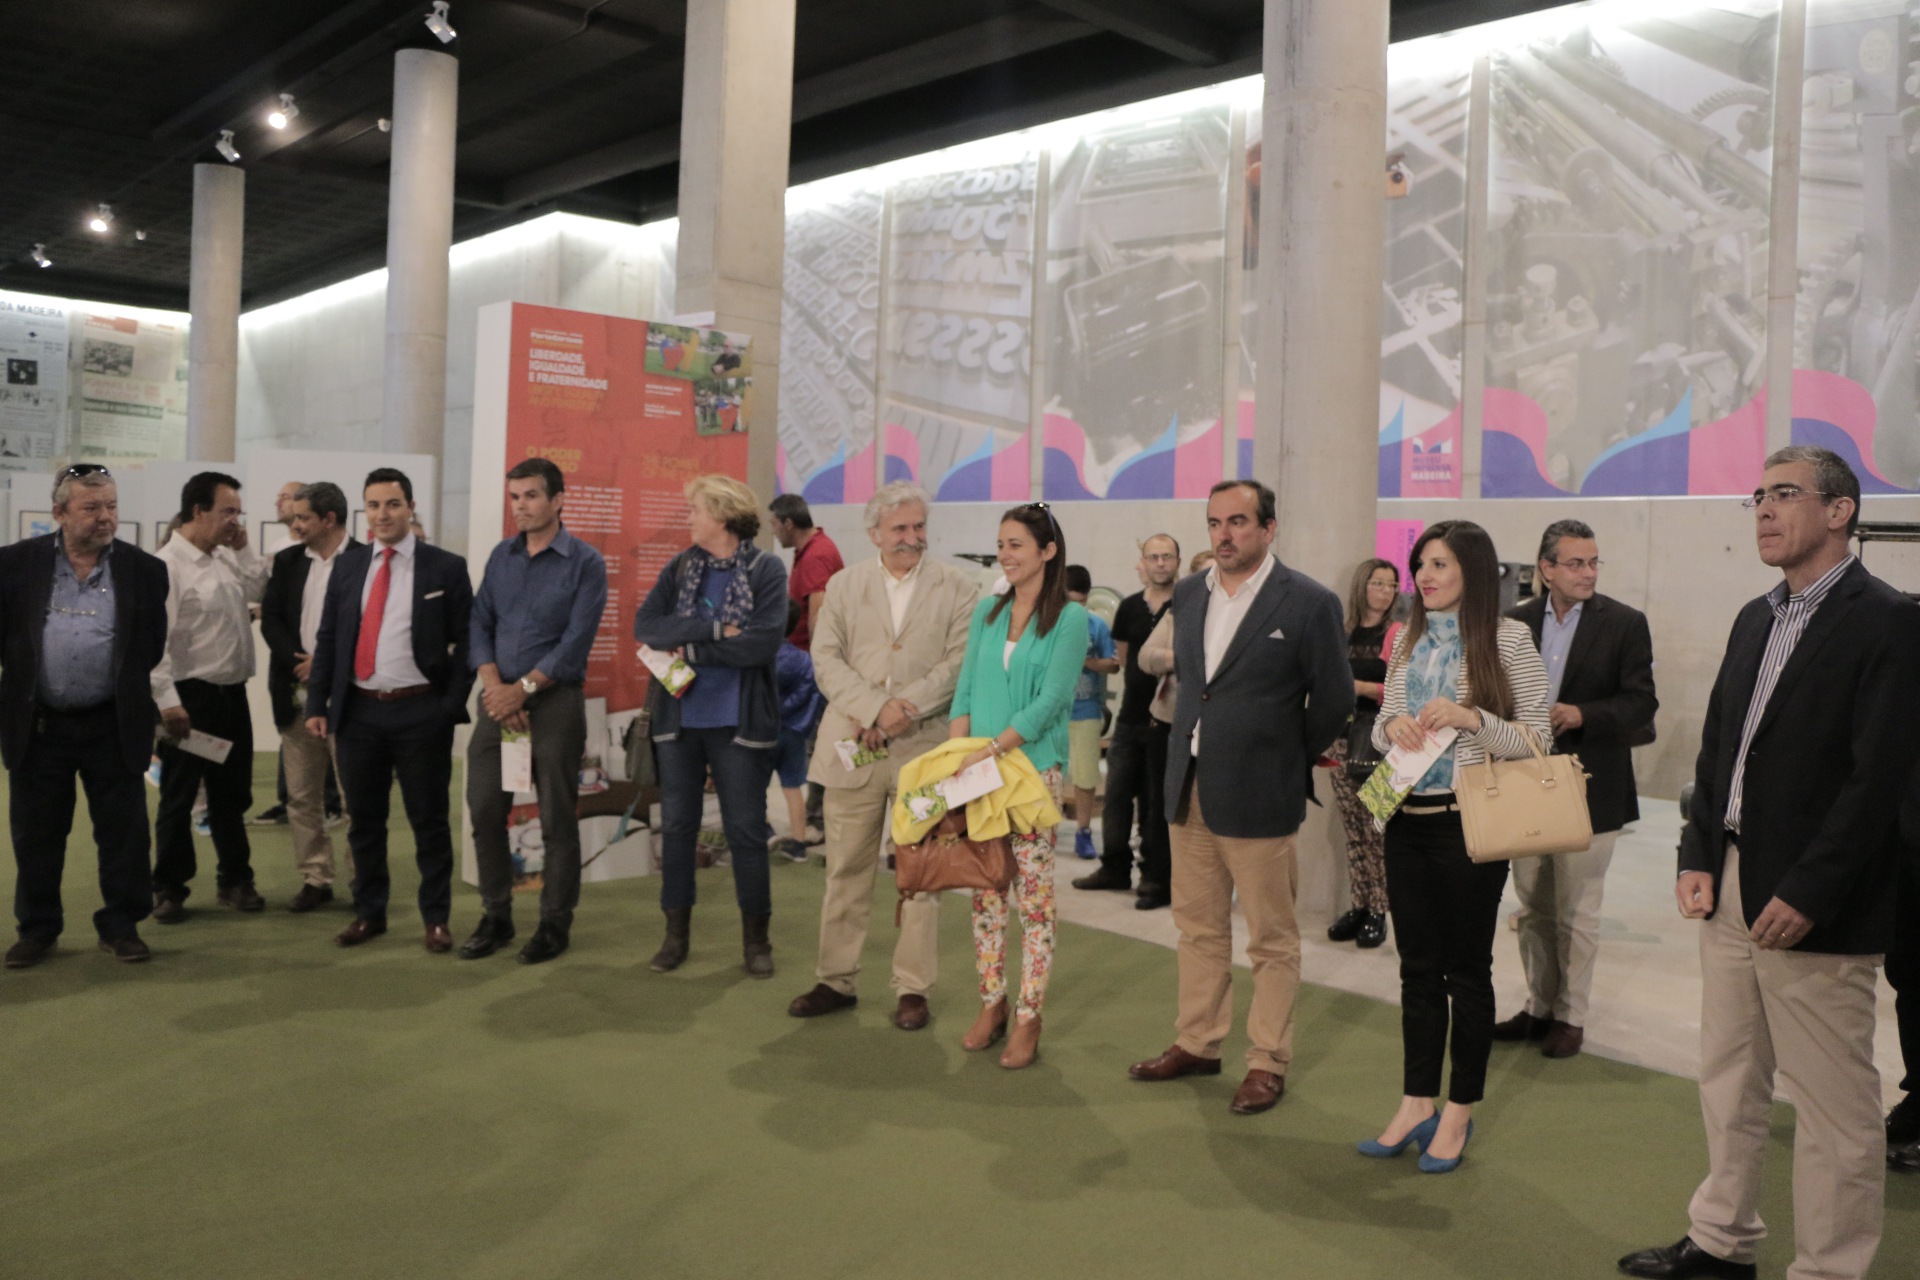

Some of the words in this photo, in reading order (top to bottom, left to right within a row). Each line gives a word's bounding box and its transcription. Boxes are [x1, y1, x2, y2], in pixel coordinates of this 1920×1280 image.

[529, 359, 585, 375] IGUALDADE
[529, 371, 535, 383] E
[536, 372, 608, 390] FRATERNIDADE
[526, 446, 537, 458] O
[540, 446, 582, 461] PODER
[1411, 471, 1451, 480] MADEIRA
